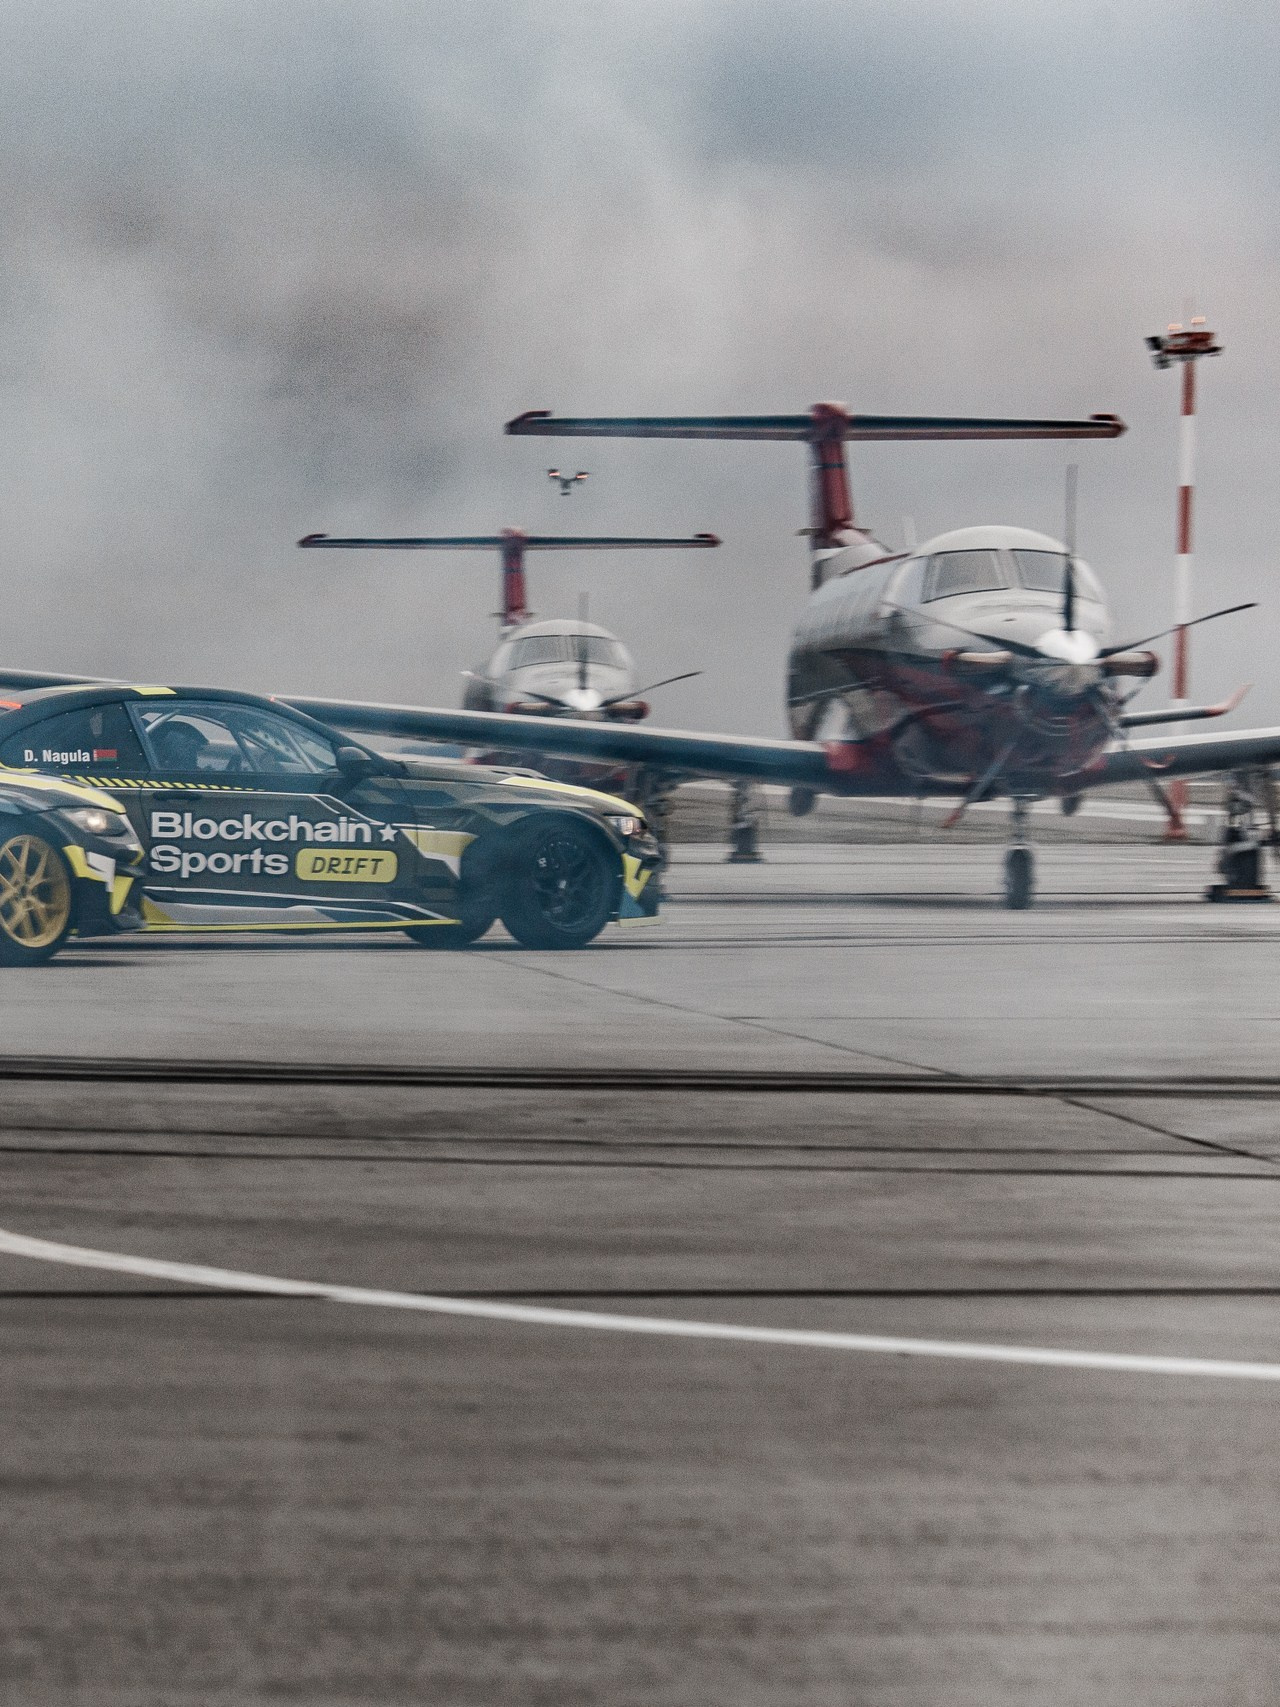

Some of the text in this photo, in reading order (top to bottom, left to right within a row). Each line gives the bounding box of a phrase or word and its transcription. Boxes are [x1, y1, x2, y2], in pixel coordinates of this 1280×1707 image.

[24, 750, 90, 764] D. Nagula
[151, 812, 372, 842] Blockchain
[151, 845, 384, 878] Sports DRIFT
